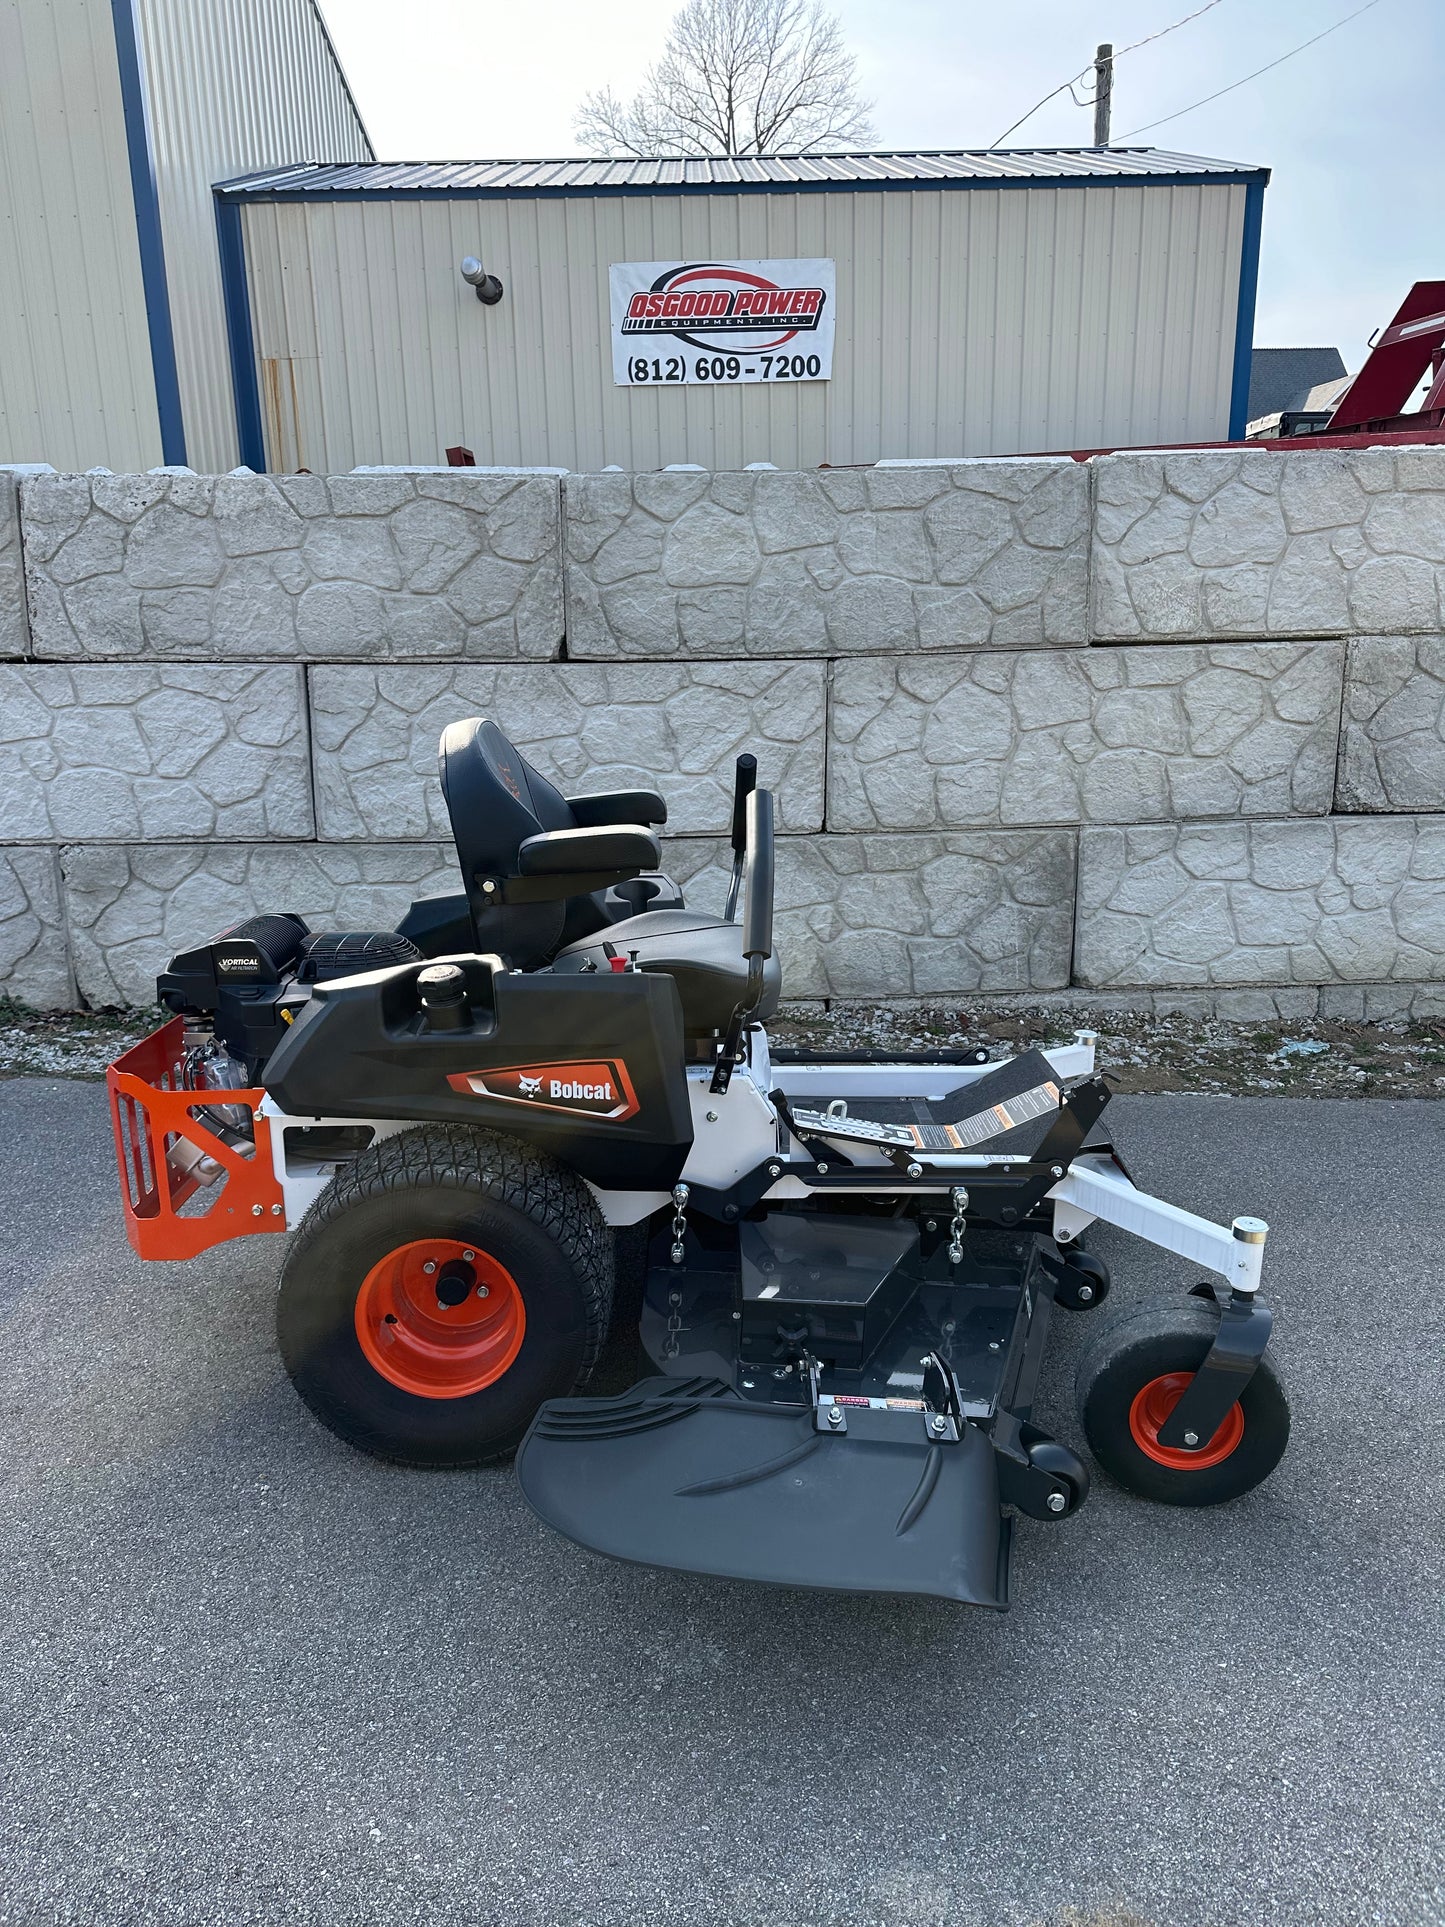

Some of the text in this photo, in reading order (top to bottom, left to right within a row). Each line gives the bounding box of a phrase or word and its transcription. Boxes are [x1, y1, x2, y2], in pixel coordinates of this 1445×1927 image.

[629, 290, 821, 318] OSGOOD POWER
[661, 318, 762, 327] EQUIPMENT,
[628, 355, 686, 383] (812)
[222, 958, 258, 966] VORTICAL
[550, 1080, 611, 1100] Bobcat
